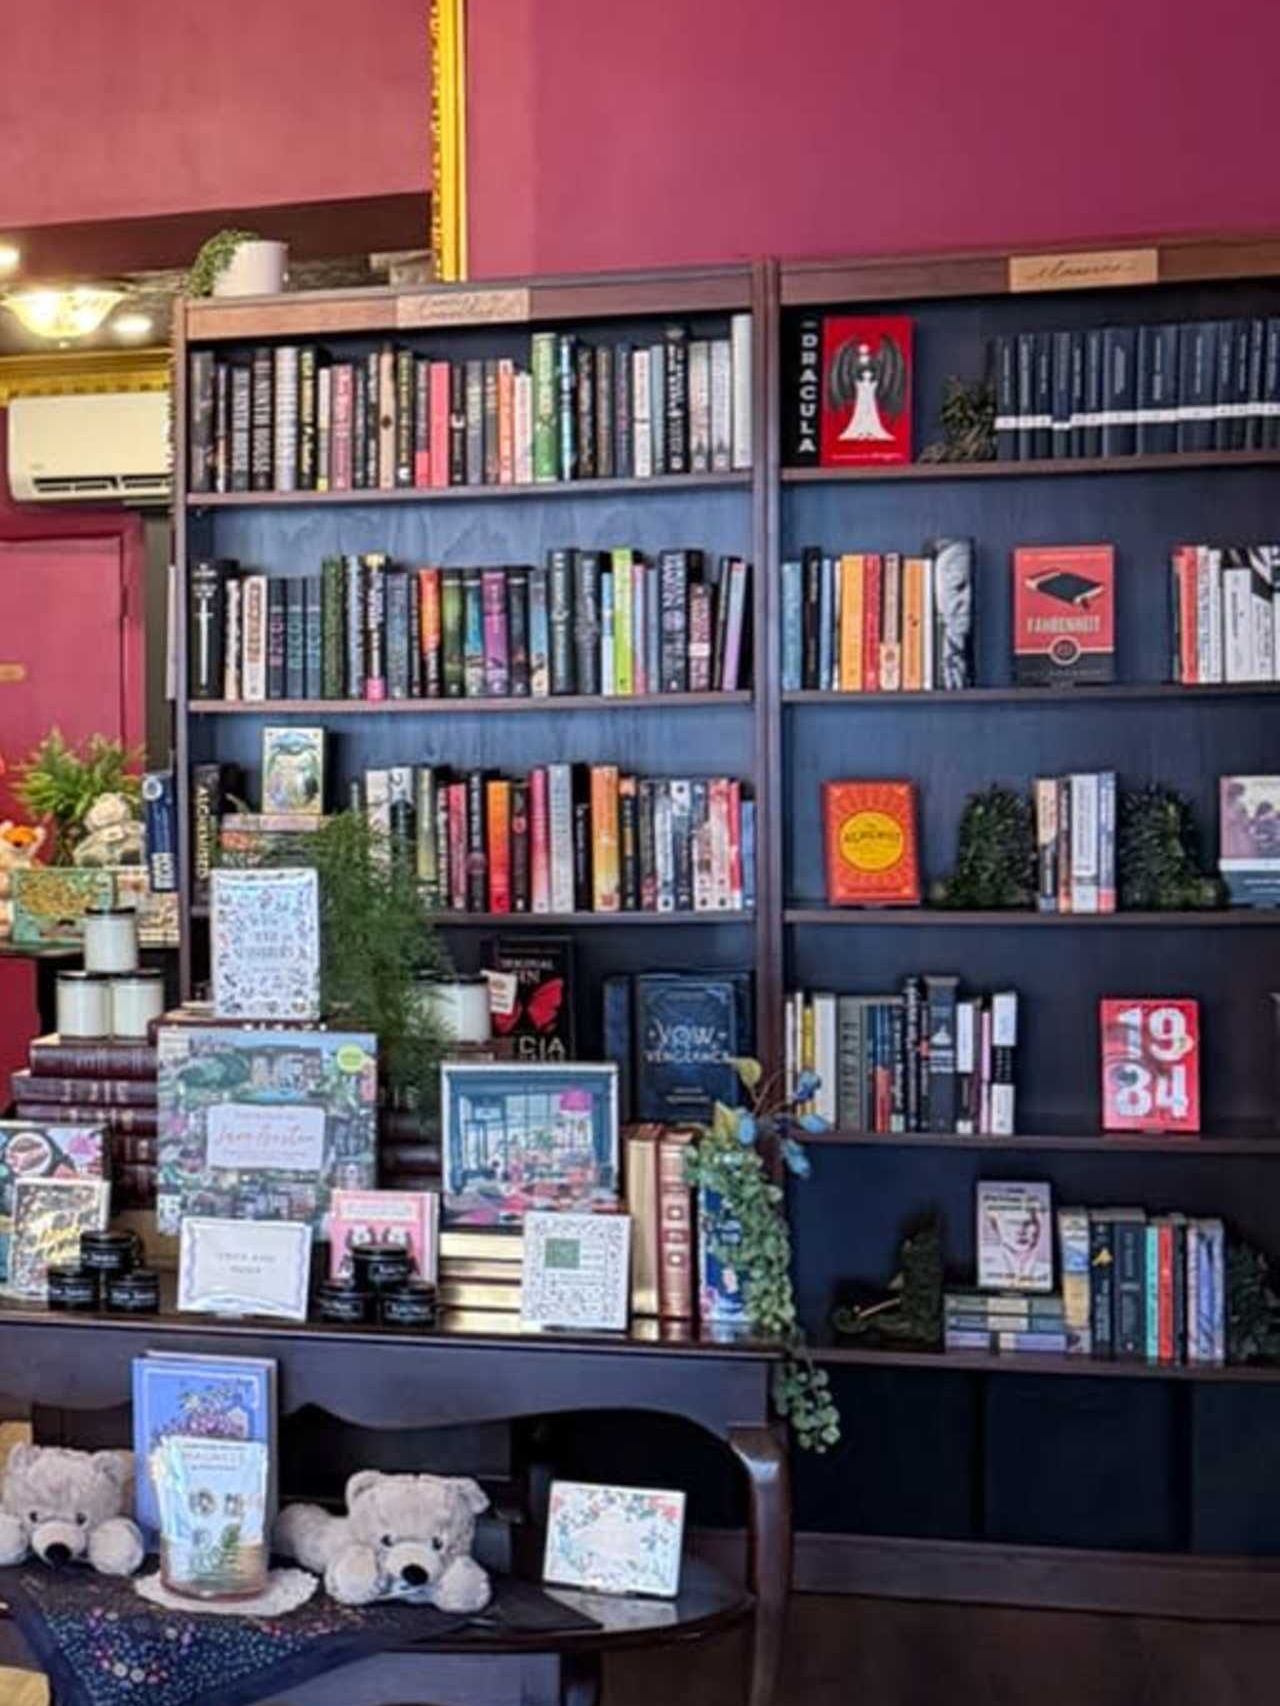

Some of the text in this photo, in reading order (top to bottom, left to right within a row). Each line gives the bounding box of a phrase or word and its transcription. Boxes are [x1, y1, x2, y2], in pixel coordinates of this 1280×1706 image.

[799, 334, 817, 453] DRACULA
[1026, 615, 1101, 634] FAHRENHEIT
[1116, 1006, 1193, 1063] 19
[1113, 1065, 1188, 1119] 84
